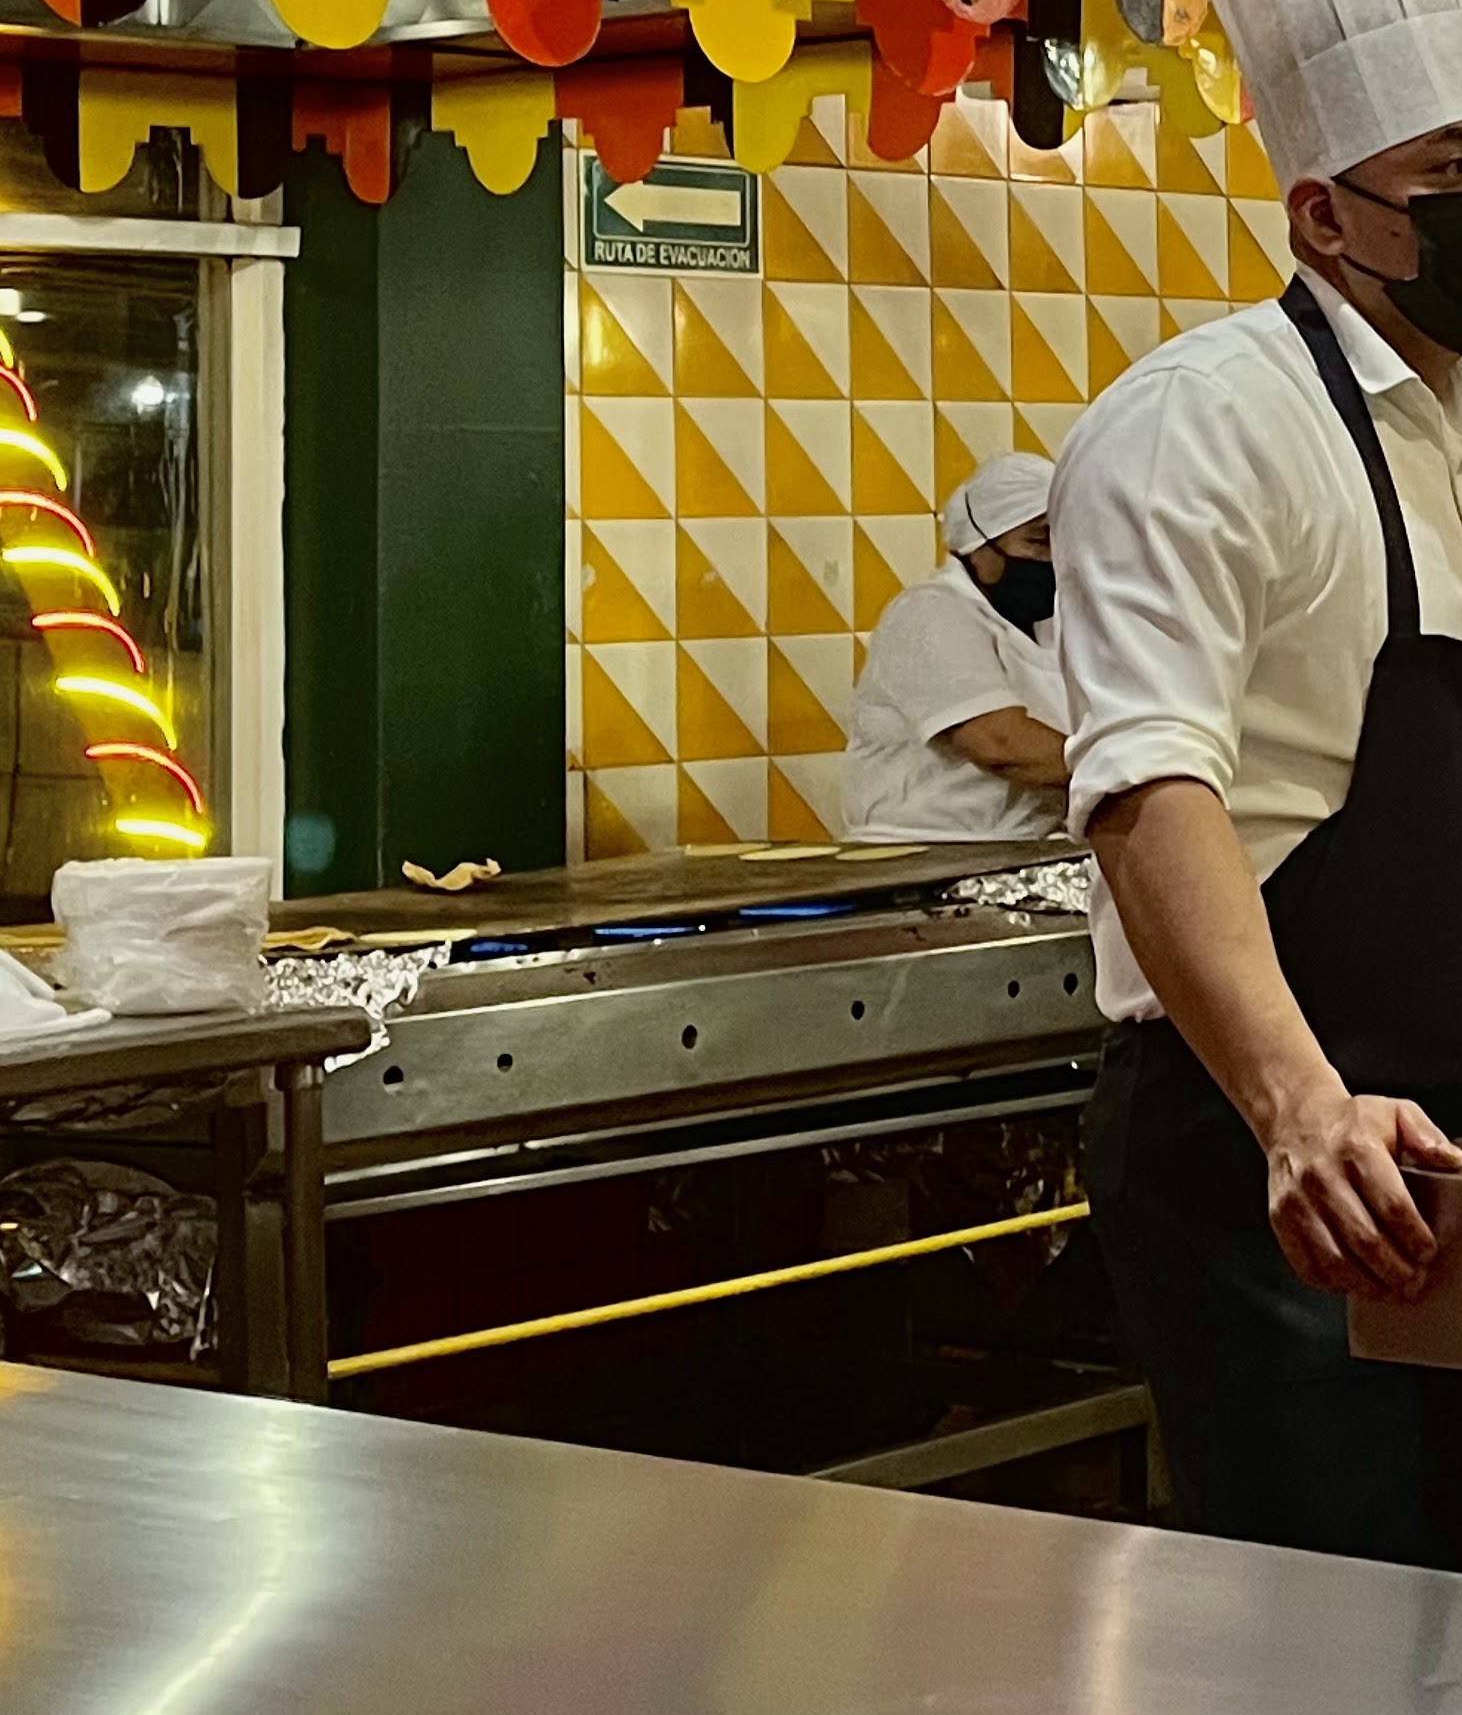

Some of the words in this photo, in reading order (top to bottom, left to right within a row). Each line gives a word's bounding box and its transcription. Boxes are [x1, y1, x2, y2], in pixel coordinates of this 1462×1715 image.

[594, 241, 634, 263] RUTA
[636, 243, 656, 265] DE
[659, 245, 750, 269] EVACUACION
